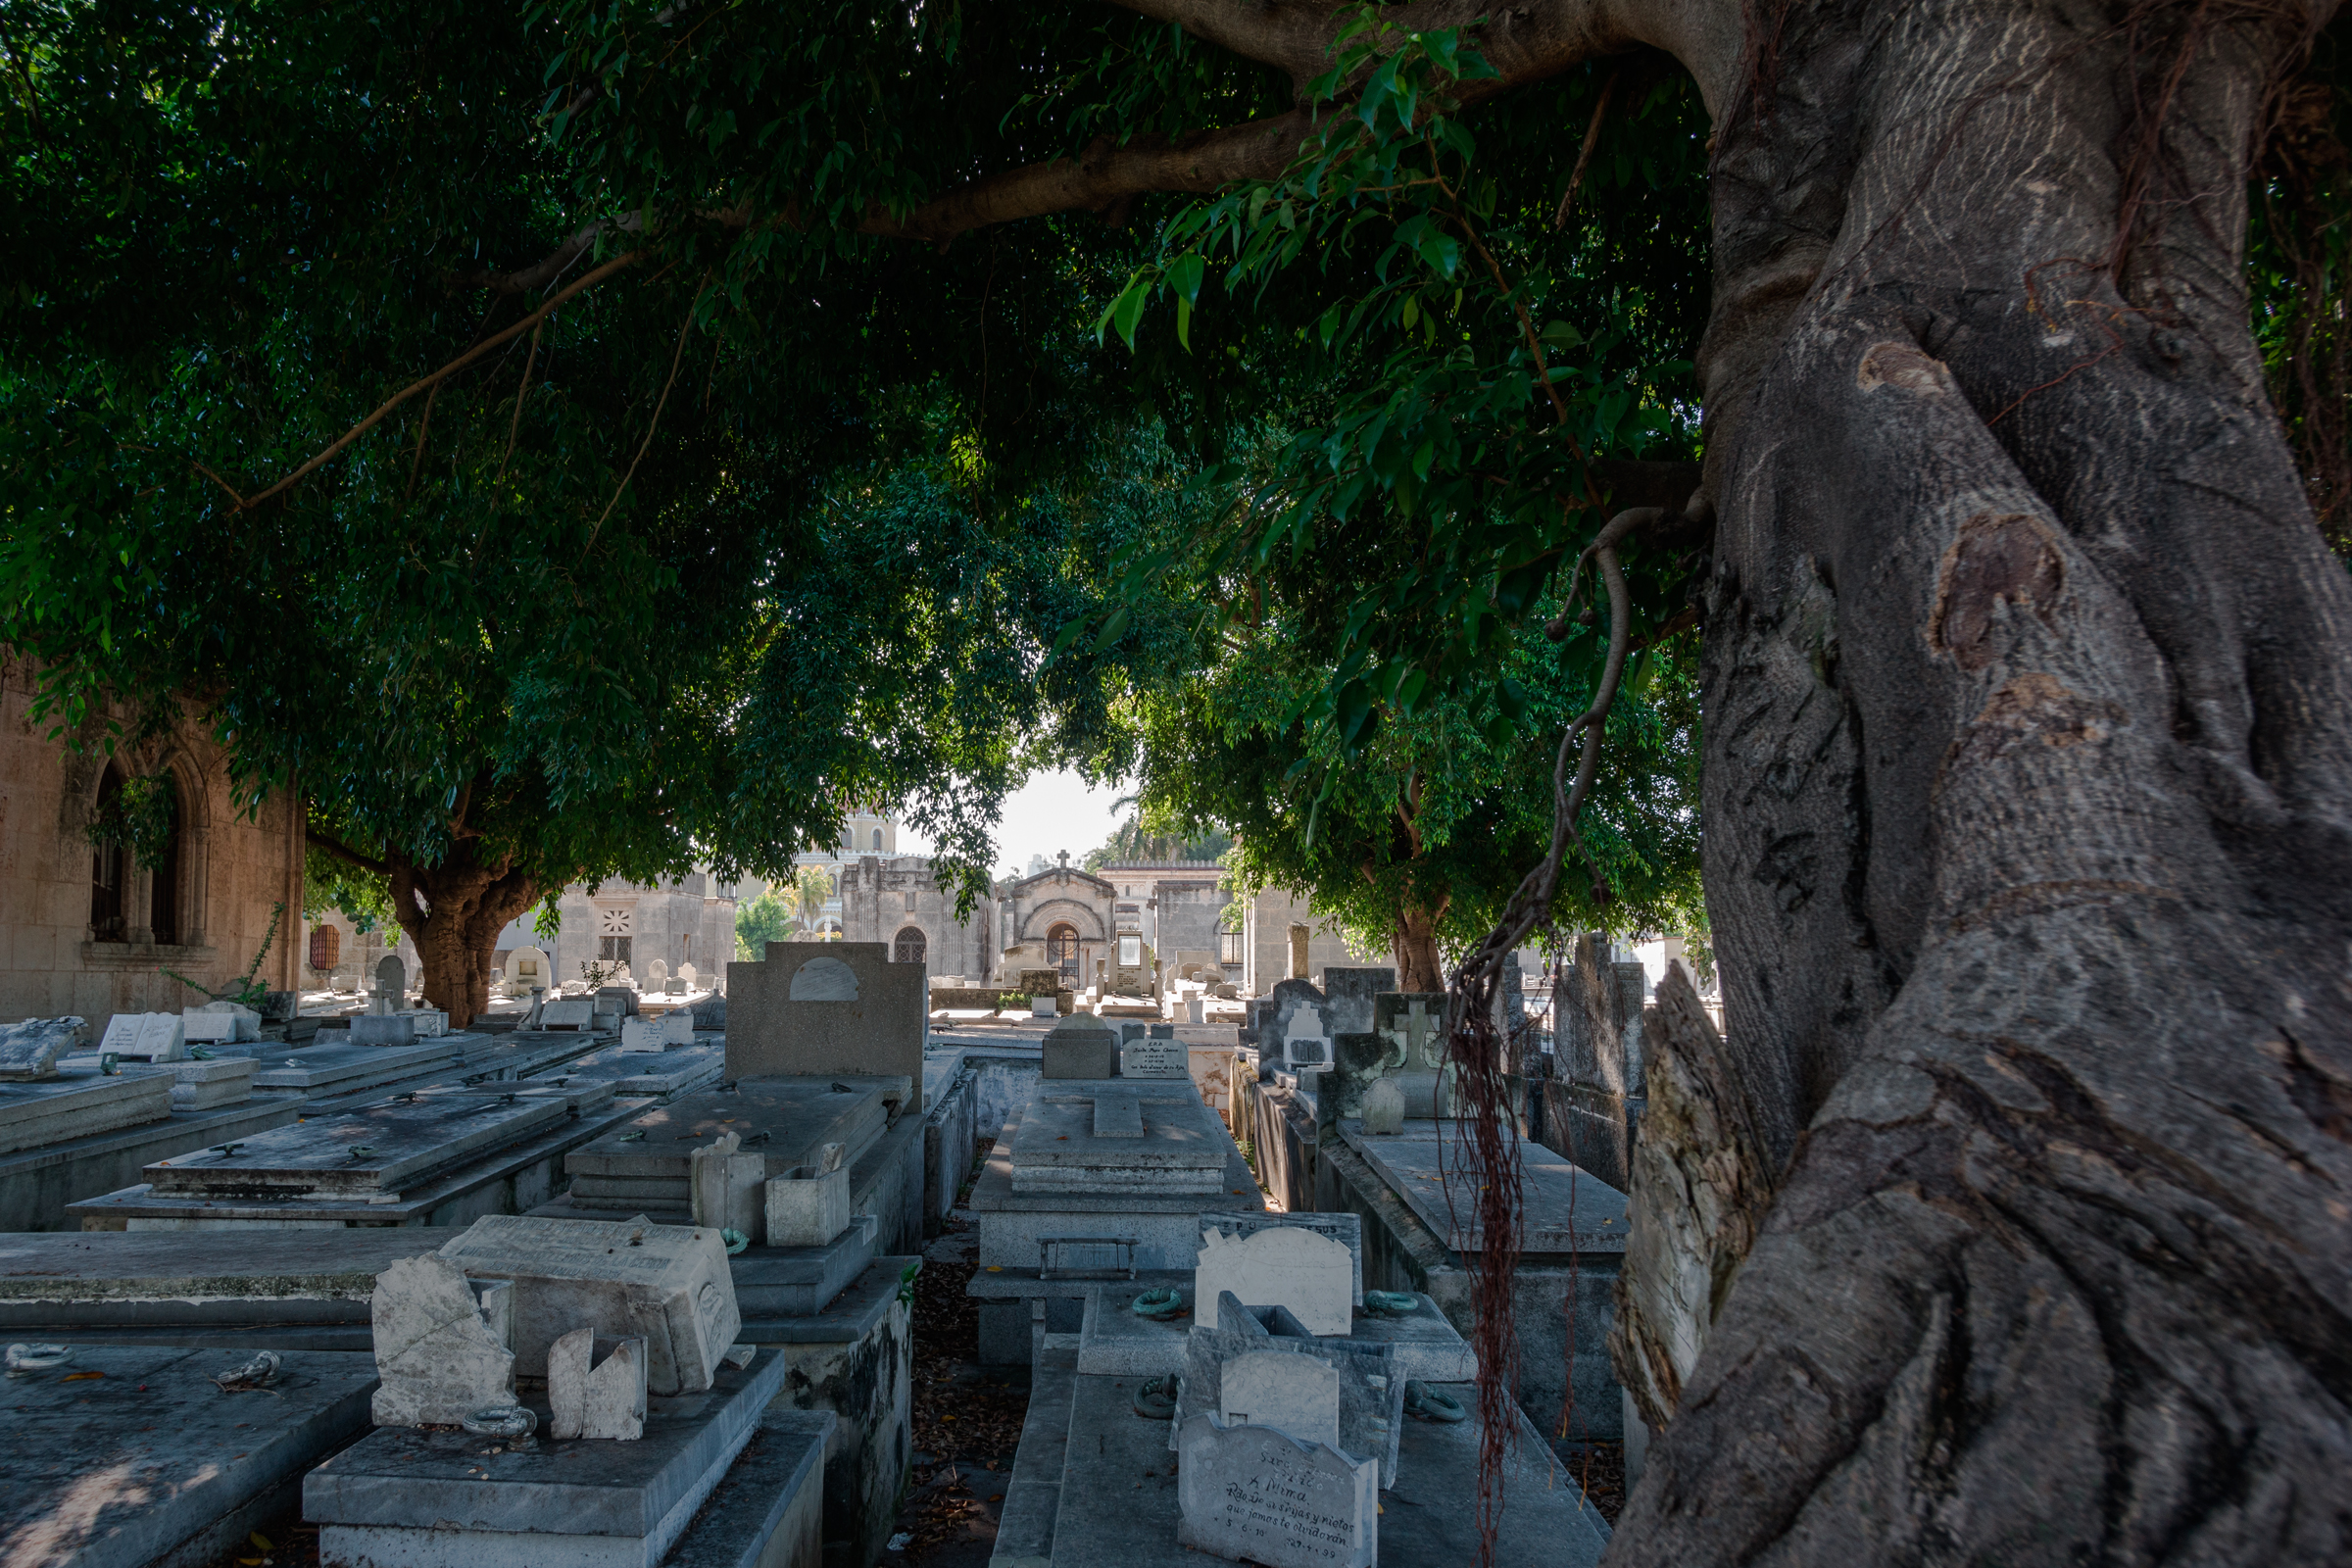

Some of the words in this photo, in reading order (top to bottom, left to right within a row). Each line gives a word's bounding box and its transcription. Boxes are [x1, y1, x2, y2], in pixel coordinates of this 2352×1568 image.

[1236, 1221, 1243, 1231] P
[1226, 1503, 1245, 1516] que
[1308, 1512, 1320, 1525] y
[1321, 1515, 1354, 1534] nietos
